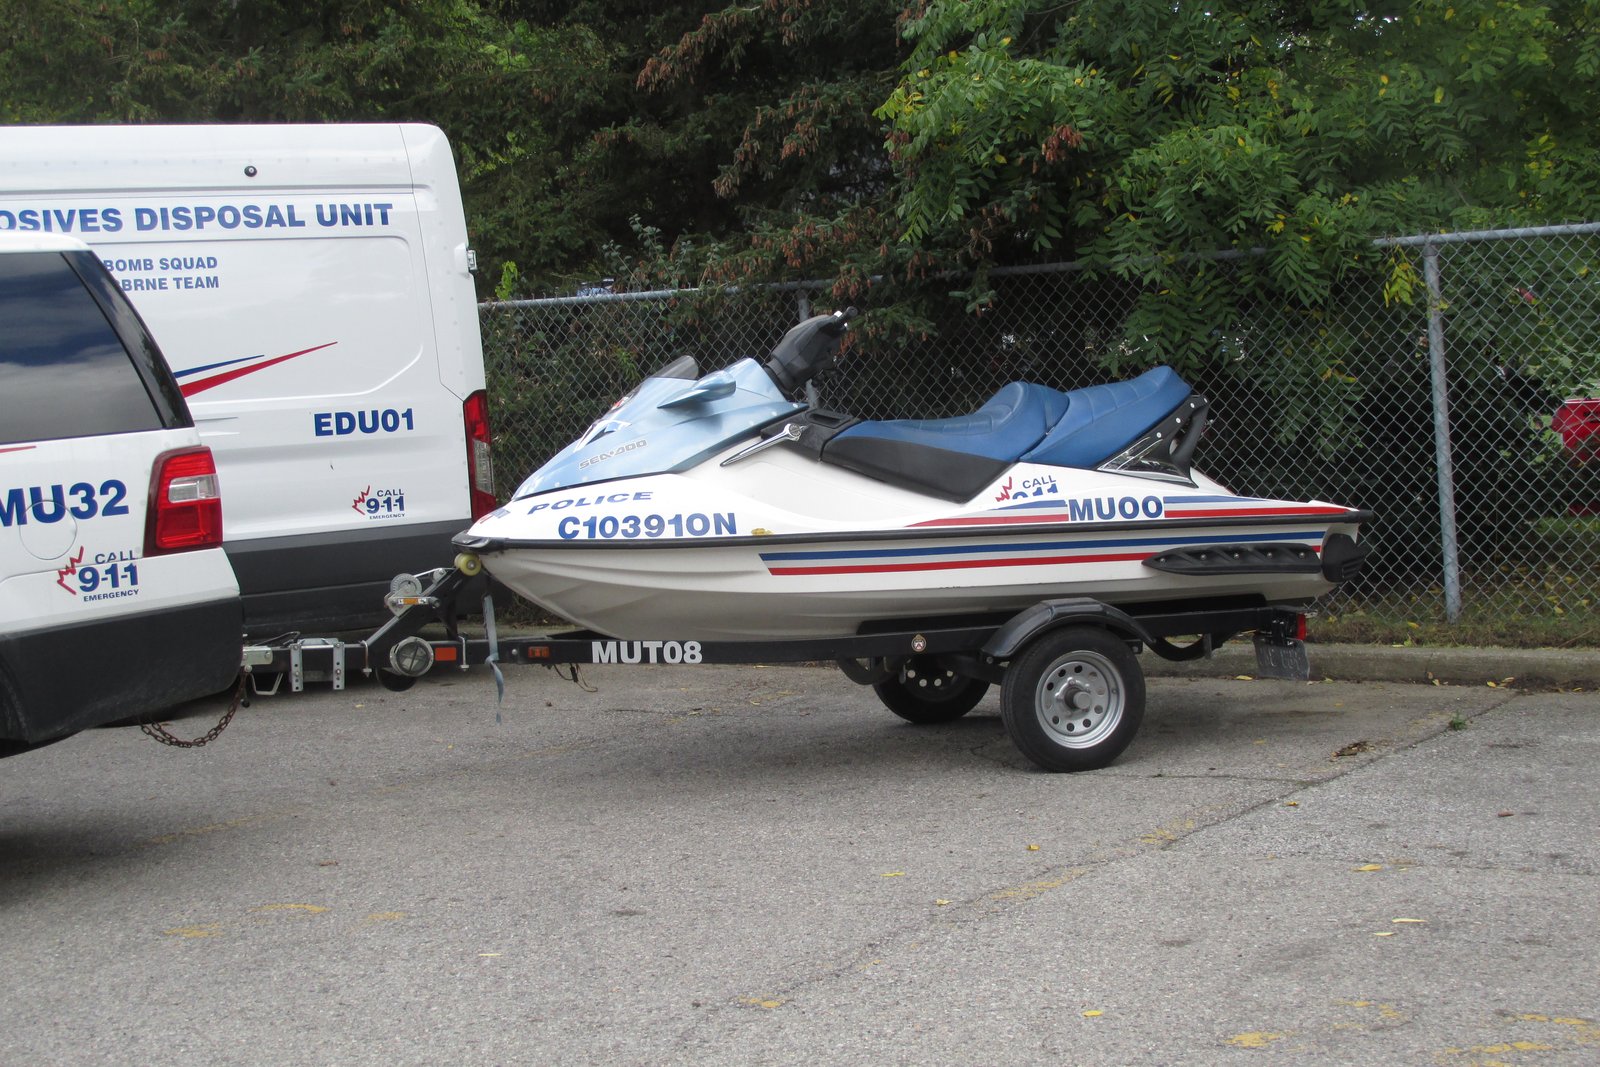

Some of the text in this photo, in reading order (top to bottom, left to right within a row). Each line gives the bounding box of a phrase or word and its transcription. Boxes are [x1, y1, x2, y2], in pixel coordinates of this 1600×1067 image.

[0, 203, 393, 232] OSIVES DISPOSAL UNIT
[103, 256, 218, 271] BOMB SQUAD
[173, 276, 220, 290] TEAM
[314, 408, 414, 437] EDU01
[1022, 474, 1057, 489] CALL
[376, 488, 405, 498] CALL
[0, 479, 130, 527] MU32
[365, 495, 405, 514] 9-1-1
[527, 491, 654, 515] POLICE
[369, 512, 406, 520] EMERGENCY
[94, 549, 137, 565] CALL
[78, 562, 139, 593] 9-1-1
[83, 588, 140, 602] EMERGENCY
[591, 640, 703, 664] MUT08
